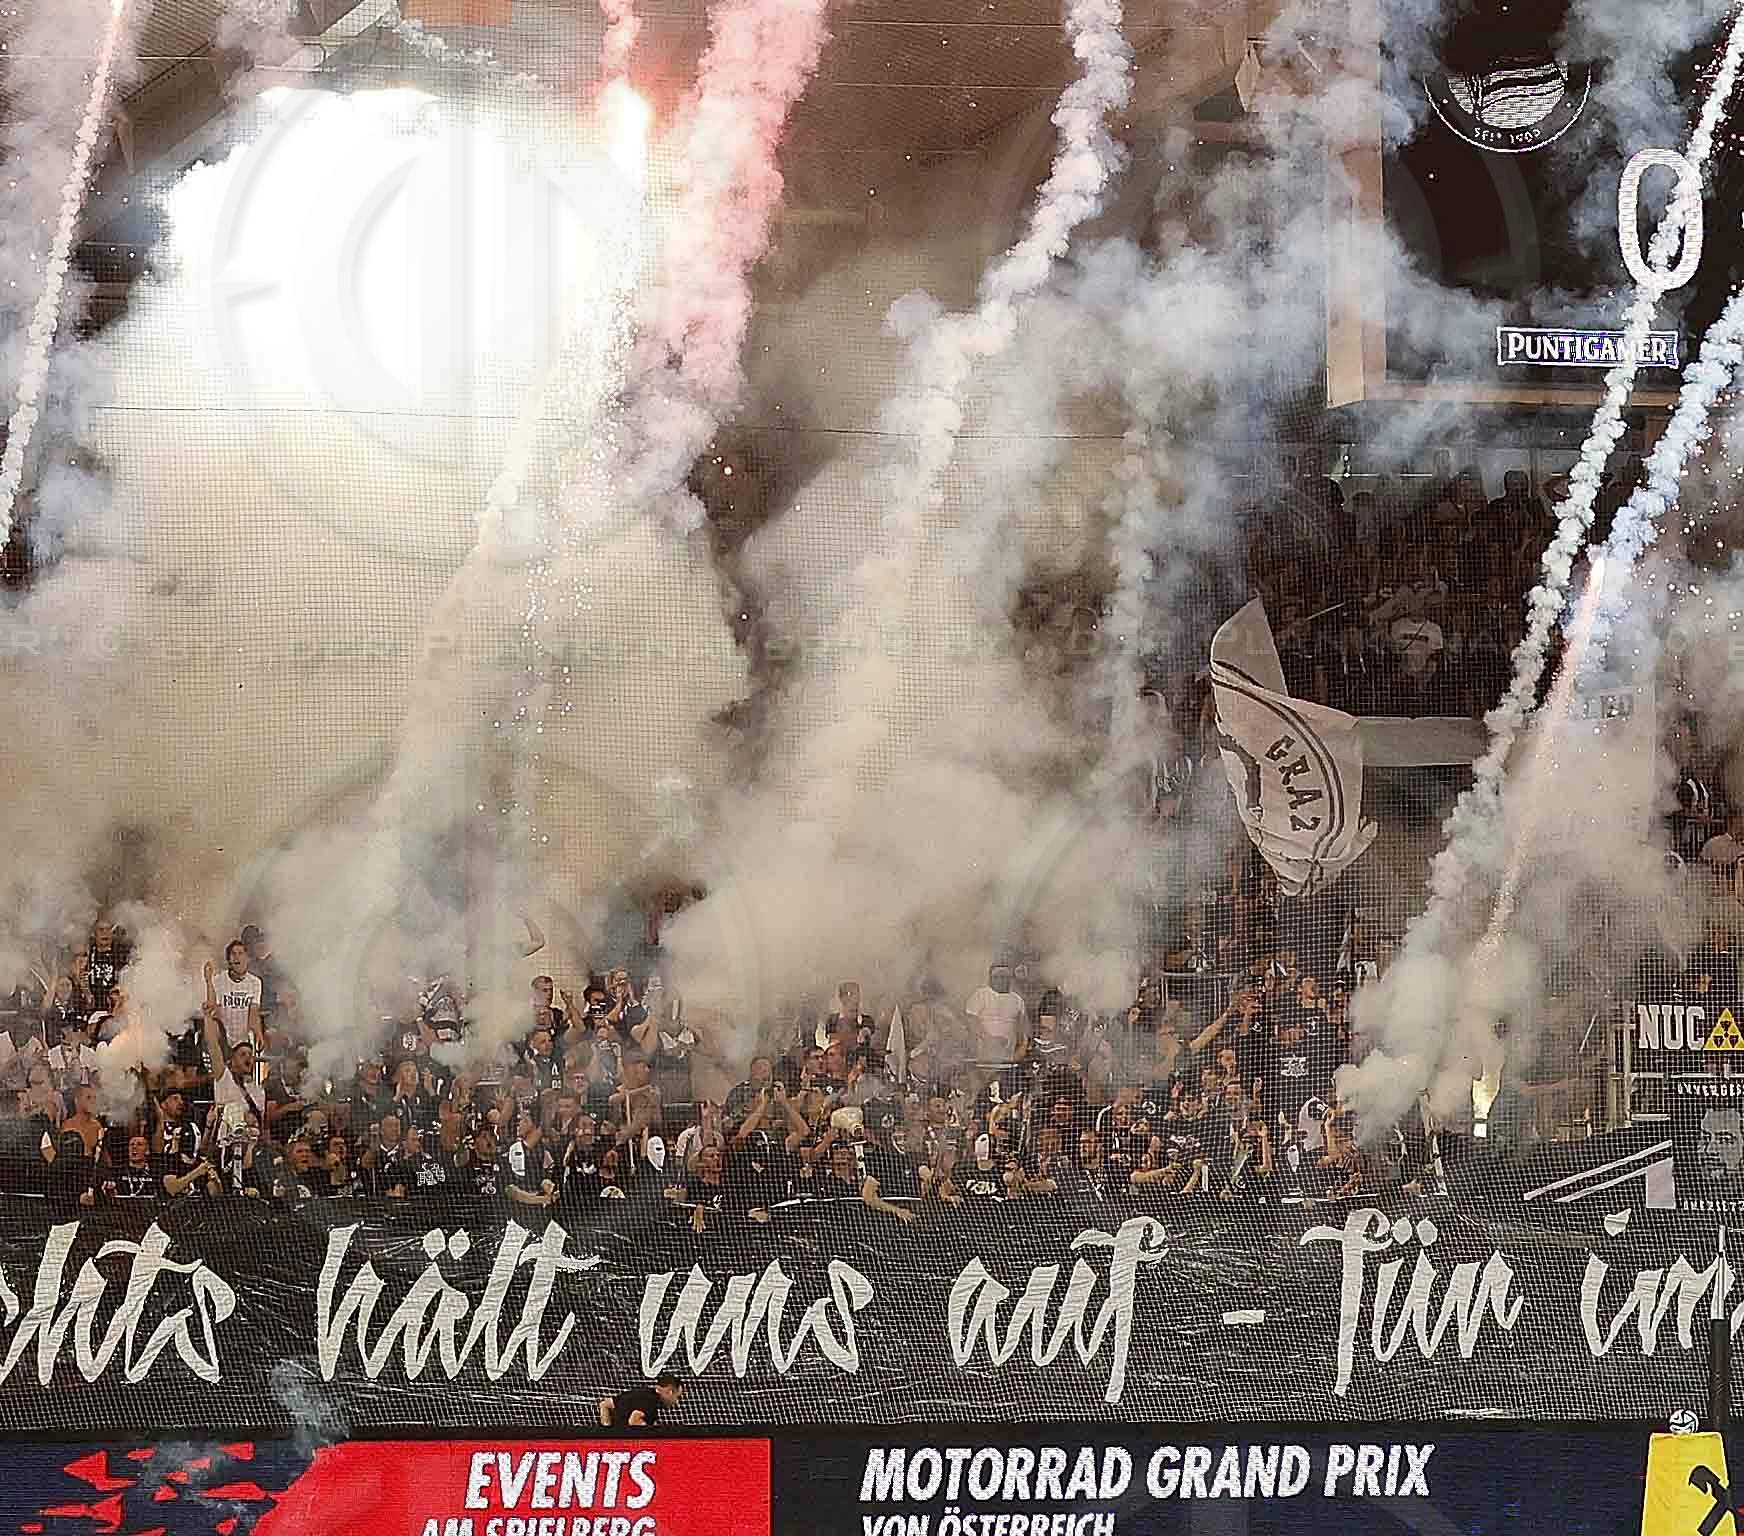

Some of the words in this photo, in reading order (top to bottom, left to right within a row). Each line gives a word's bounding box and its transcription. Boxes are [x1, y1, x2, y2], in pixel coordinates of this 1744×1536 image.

[1618, 148, 1704, 293] 0
[316, 1218, 601, 1382] hält
[639, 1257, 875, 1376] uns
[948, 1215, 1170, 1403] auf
[1299, 1207, 1525, 1396] für
[464, 1450, 658, 1510] EVENTS
[858, 1446, 1134, 1502] MOTORRAD
[1145, 1444, 1312, 1498] GRAND
[1323, 1443, 1436, 1496] PRIX
[482, 1516, 657, 1536] SPIELBERG
[862, 1514, 932, 1536] VON
[937, 1506, 1117, 1536] ÖSTERREICH
